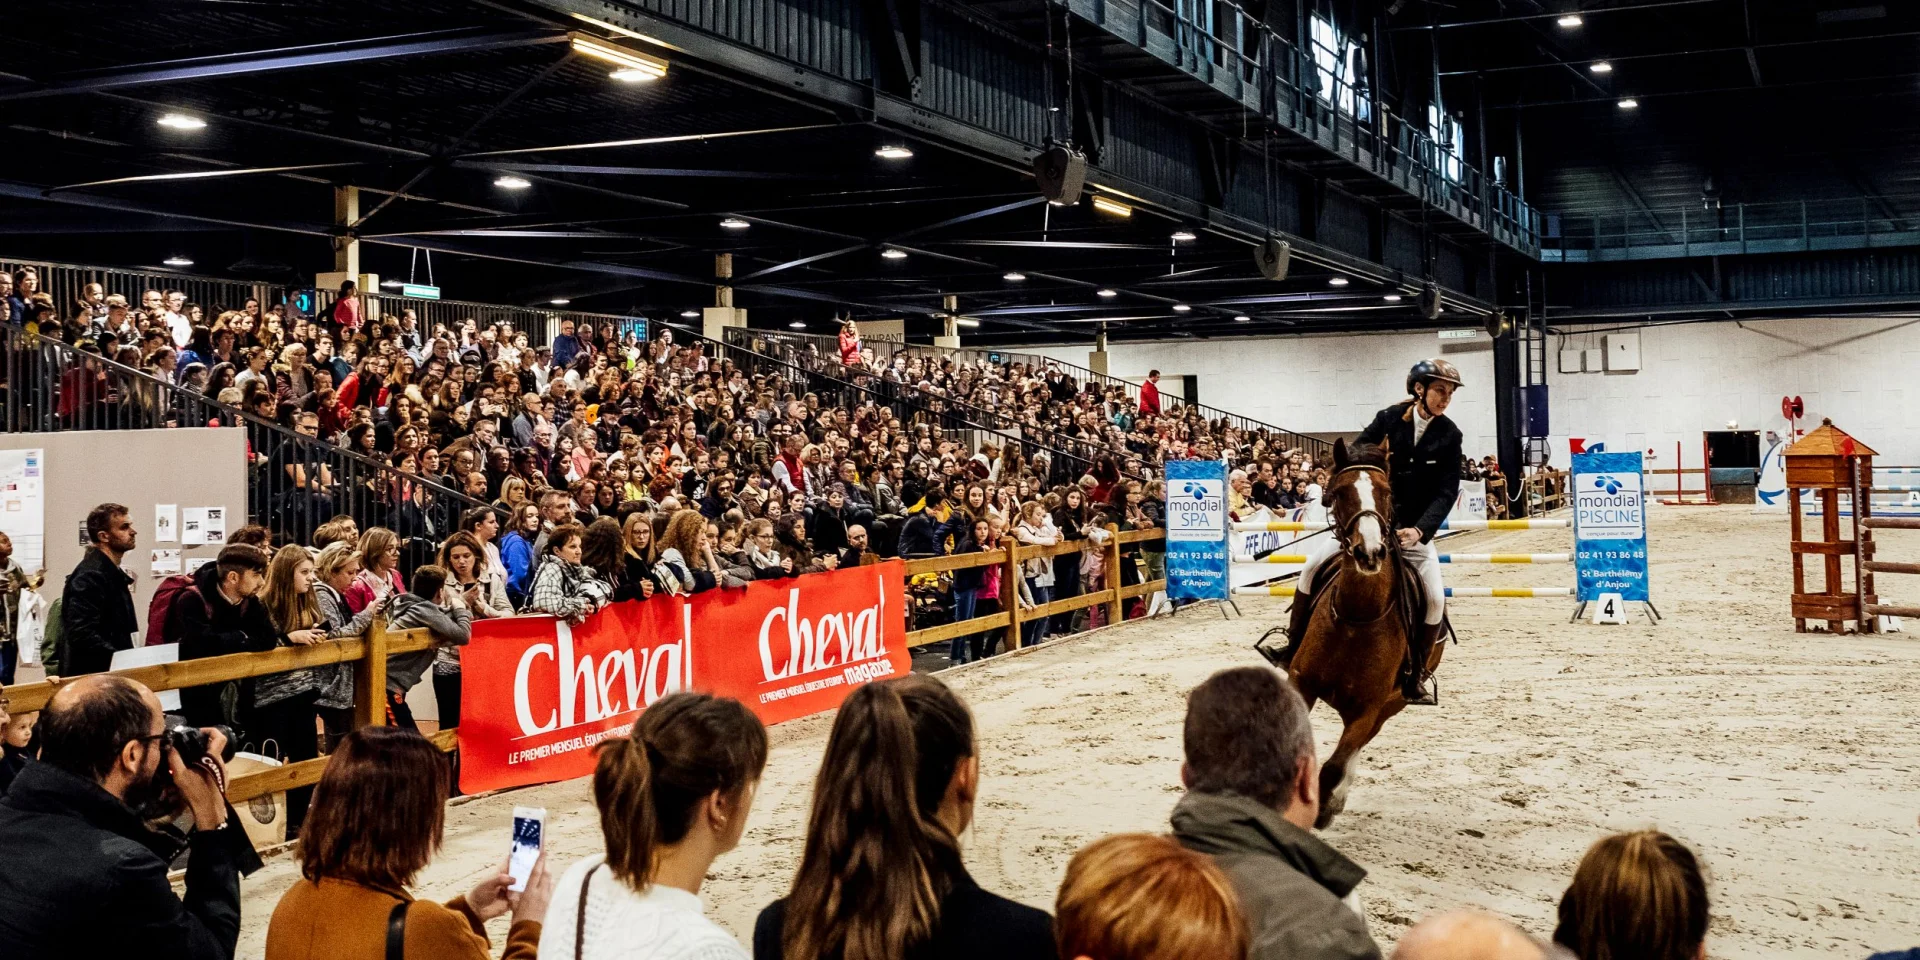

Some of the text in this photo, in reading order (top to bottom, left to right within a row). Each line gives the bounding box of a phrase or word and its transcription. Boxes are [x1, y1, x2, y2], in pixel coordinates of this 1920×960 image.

[1579, 494, 1639, 507] mondial
[1912, 493, 1918, 501] A
[1169, 499, 1222, 511] mondial
[1181, 512, 1210, 527] SPA
[1580, 509, 1640, 523] PISCINE
[1243, 530, 1280, 555] FFE.COM
[1168, 552, 1224, 560] 02 41 93 86 48
[1170, 569, 1178, 577] St
[1581, 569, 1591, 578] St
[1181, 579, 1211, 589] d'Anjou
[1596, 580, 1630, 590] d'Anjou
[1604, 598, 1615, 617] 4
[759, 574, 886, 681] Cheval
[514, 603, 693, 736] Cheval
[843, 656, 896, 685] magazine
[759, 692, 768, 704] LE
[766, 688, 788, 702] PREMIER
[786, 683, 807, 697] MENSUEL
[508, 752, 519, 765] LE
[519, 744, 554, 763] PREMIER
[551, 737, 587, 755] MENSUEL
